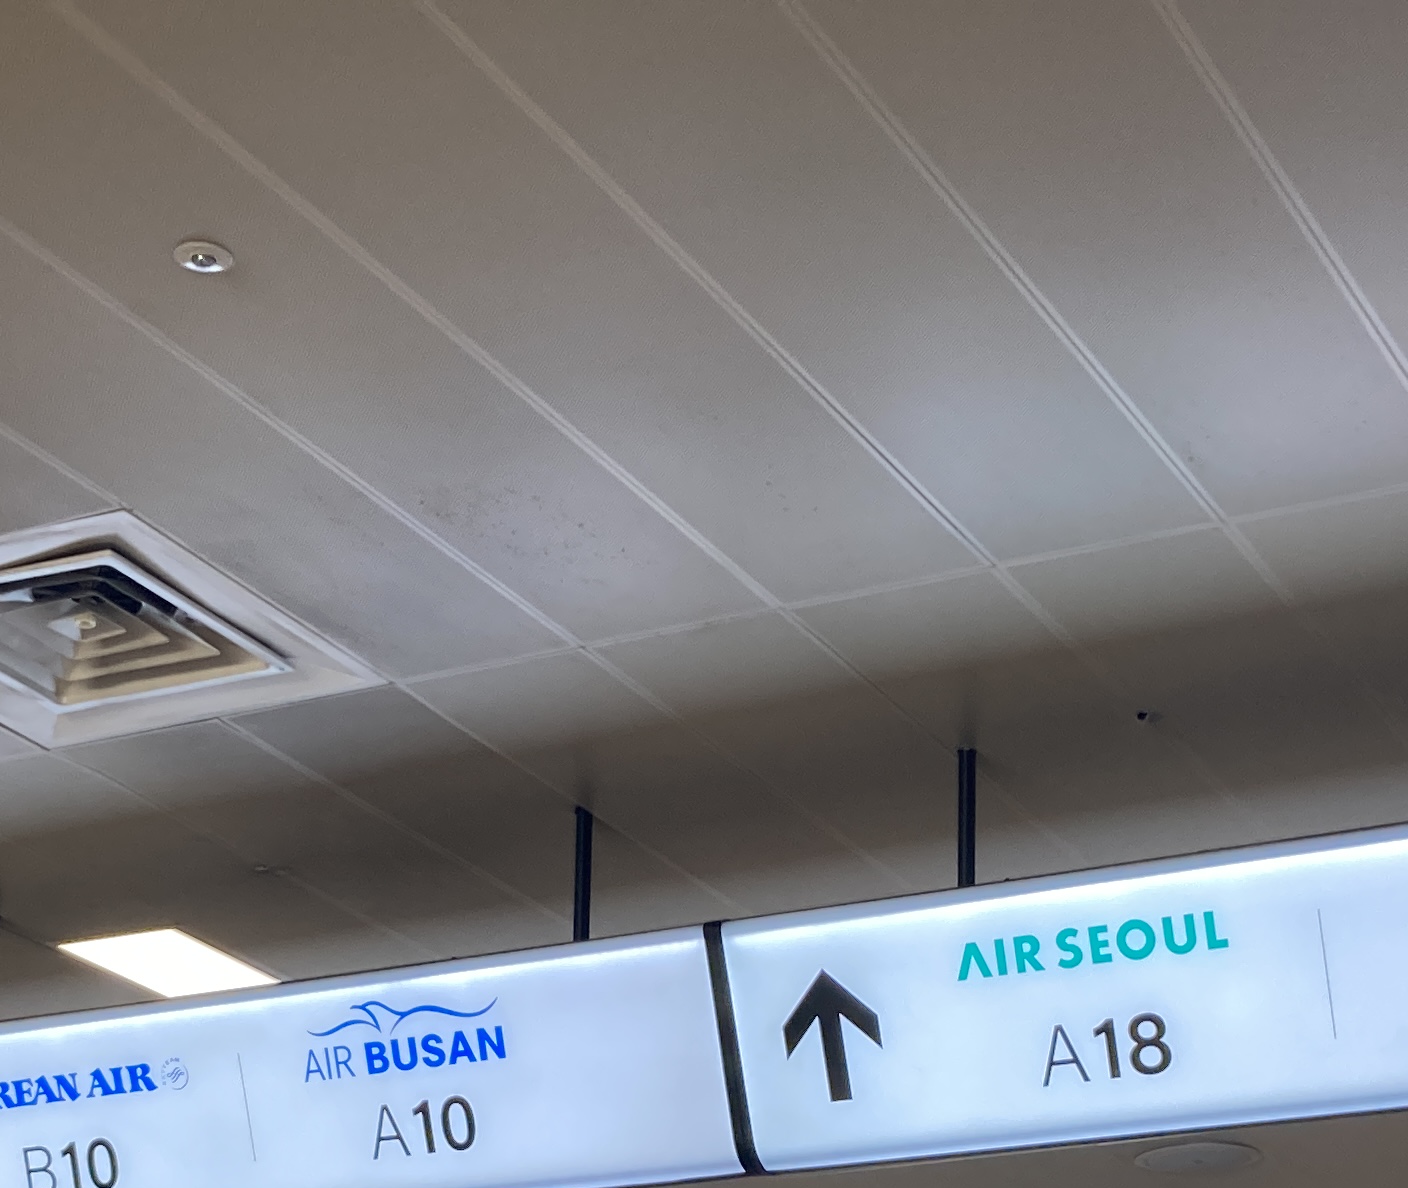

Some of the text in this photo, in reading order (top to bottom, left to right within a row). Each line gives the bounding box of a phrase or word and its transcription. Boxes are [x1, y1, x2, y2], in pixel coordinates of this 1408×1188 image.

[957, 910, 1229, 982] AIR SEOUL
[87, 1062, 159, 1098] AIR
[304, 1025, 506, 1084] AIR BUSAN
[1042, 1011, 1172, 1088] A18
[373, 1094, 476, 1161] A10
